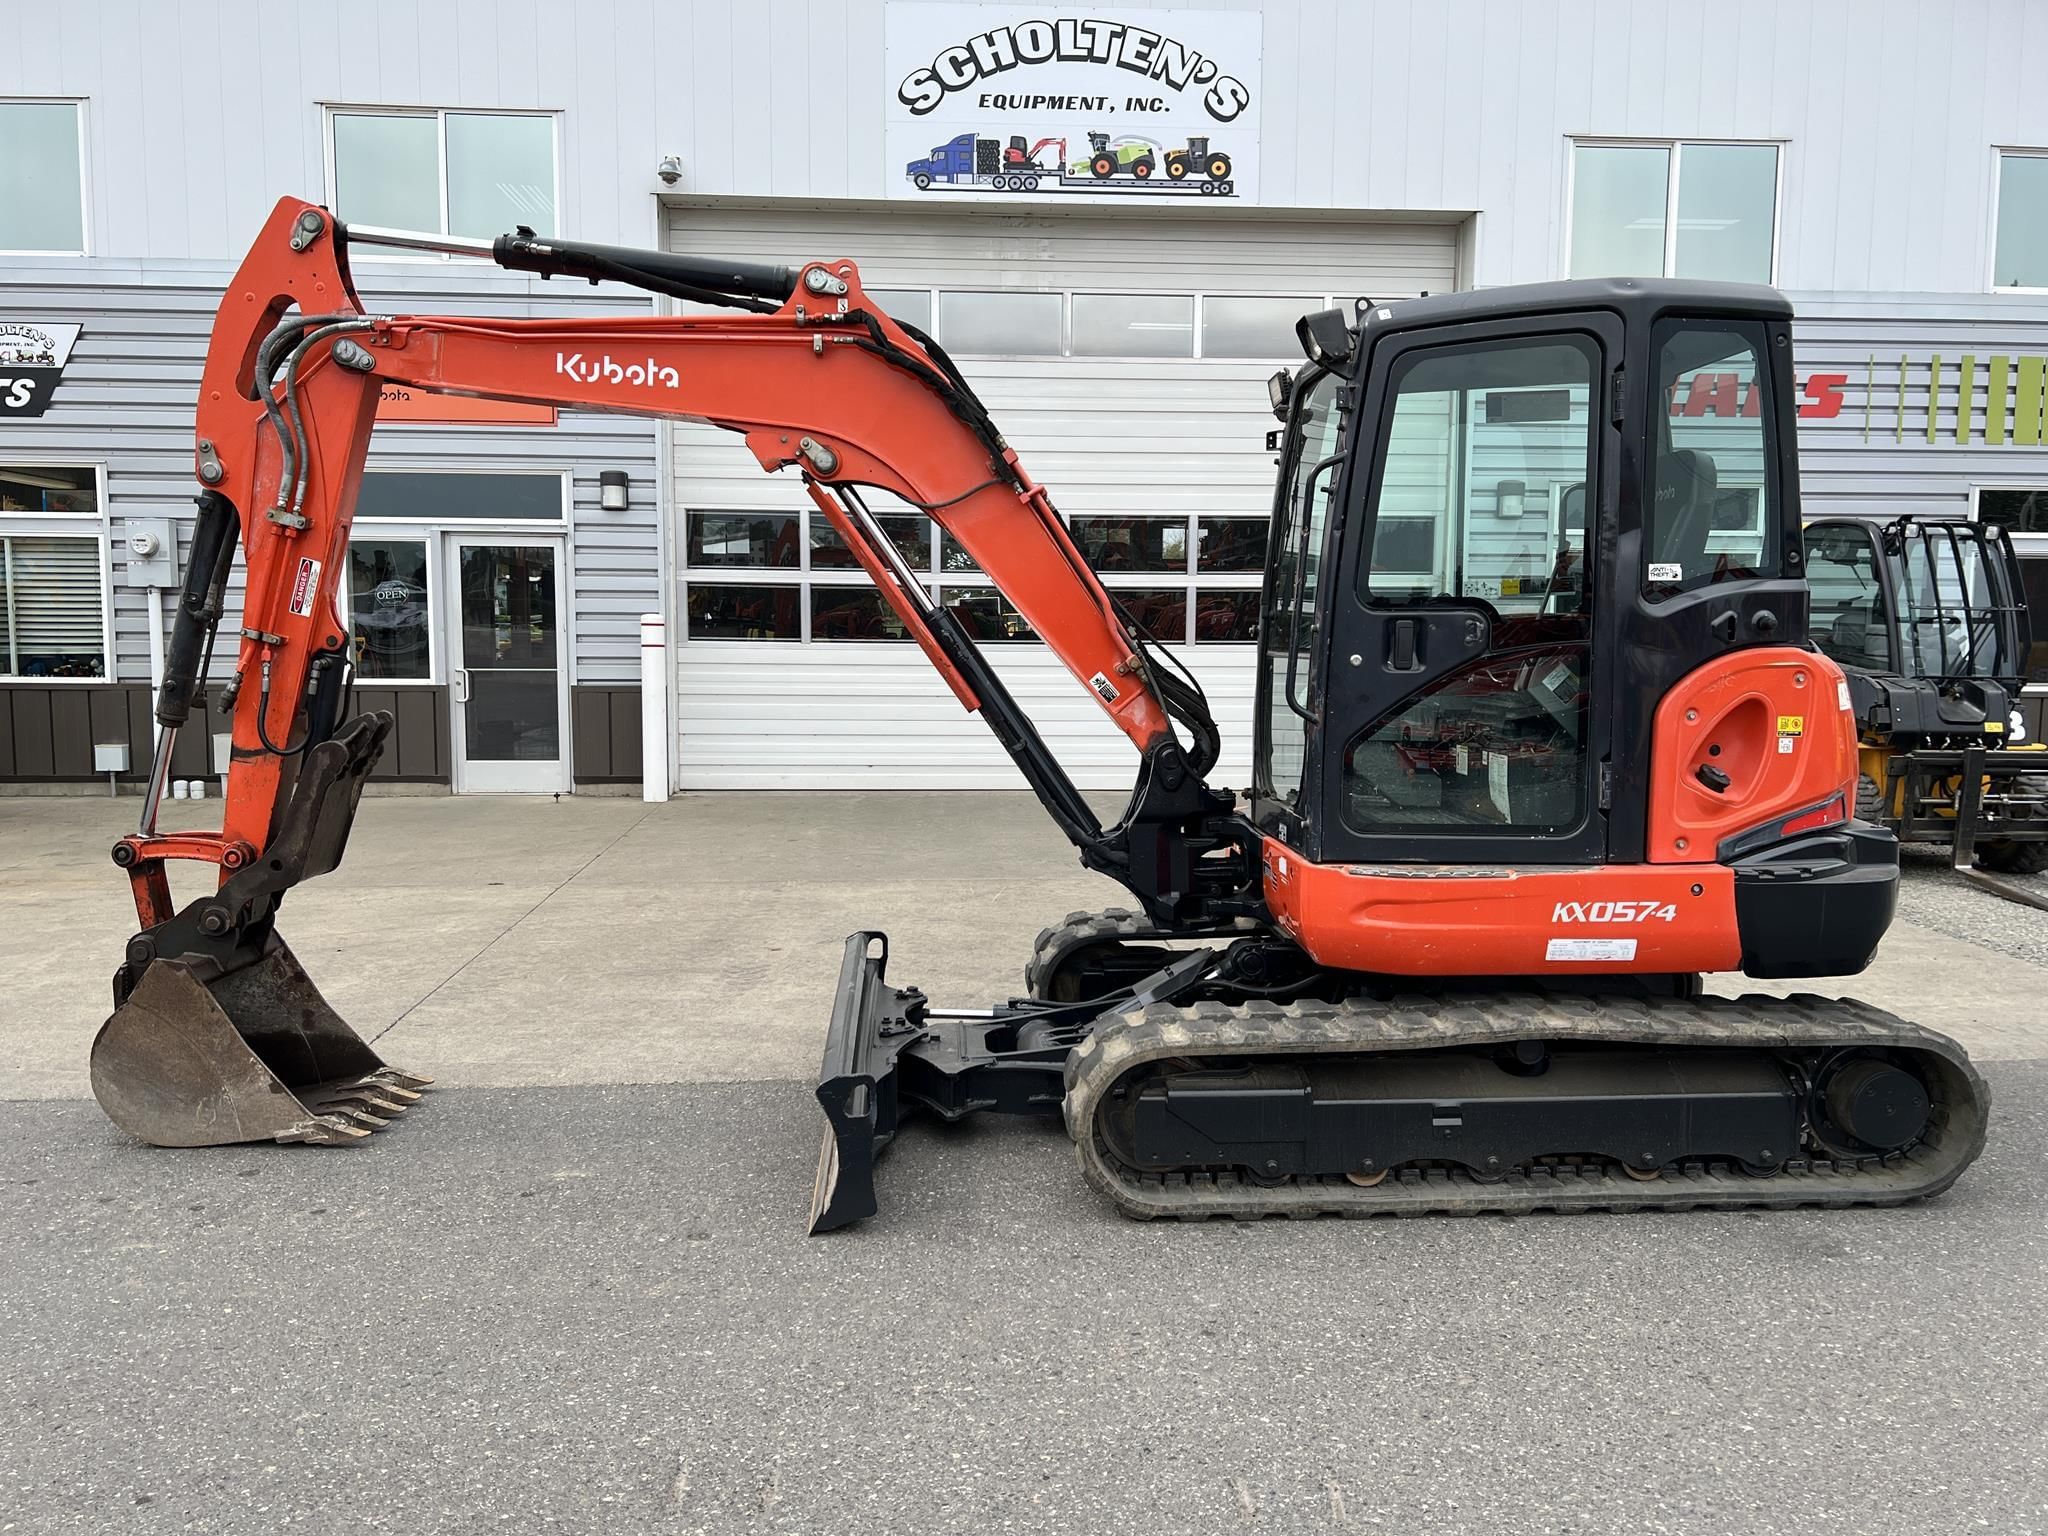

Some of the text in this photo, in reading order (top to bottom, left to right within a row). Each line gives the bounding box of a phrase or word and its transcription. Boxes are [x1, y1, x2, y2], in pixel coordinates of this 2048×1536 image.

[898, 18, 1250, 123] SCHOLTEN'S
[978, 93, 1171, 114] EQUIPMENT, INC.
[556, 352, 680, 389] Kubota
[296, 571, 309, 602] DANGER
[376, 590, 407, 600] OPEN
